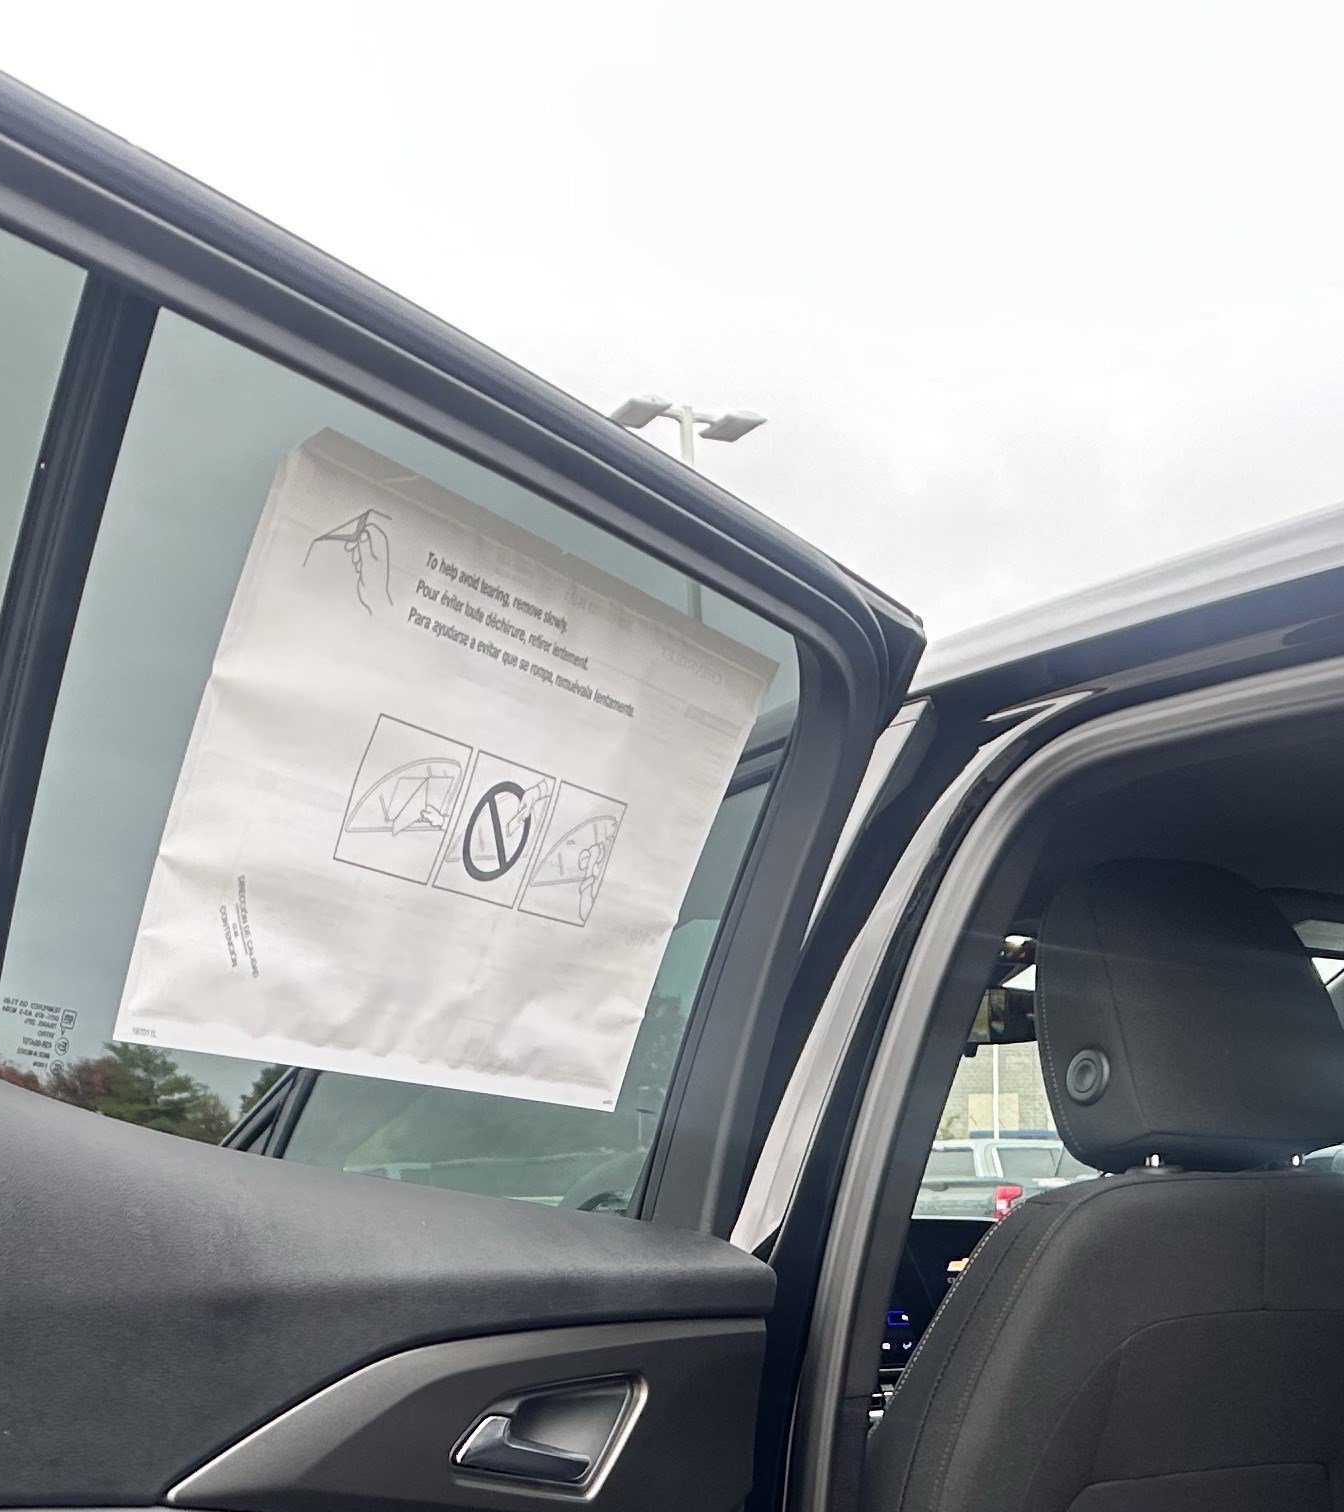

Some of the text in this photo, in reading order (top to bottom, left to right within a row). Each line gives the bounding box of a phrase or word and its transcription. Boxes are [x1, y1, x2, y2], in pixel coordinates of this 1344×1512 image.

[415, 578, 441, 601] Pour
[426, 551, 438, 570] To
[439, 557, 458, 582] help
[458, 570, 481, 591] avoid
[512, 597, 543, 620] remove
[408, 606, 432, 630] Para
[469, 637, 477, 650] a
[476, 640, 502, 660] evitar
[501, 650, 519, 667] que
[519, 658, 530, 672] se
